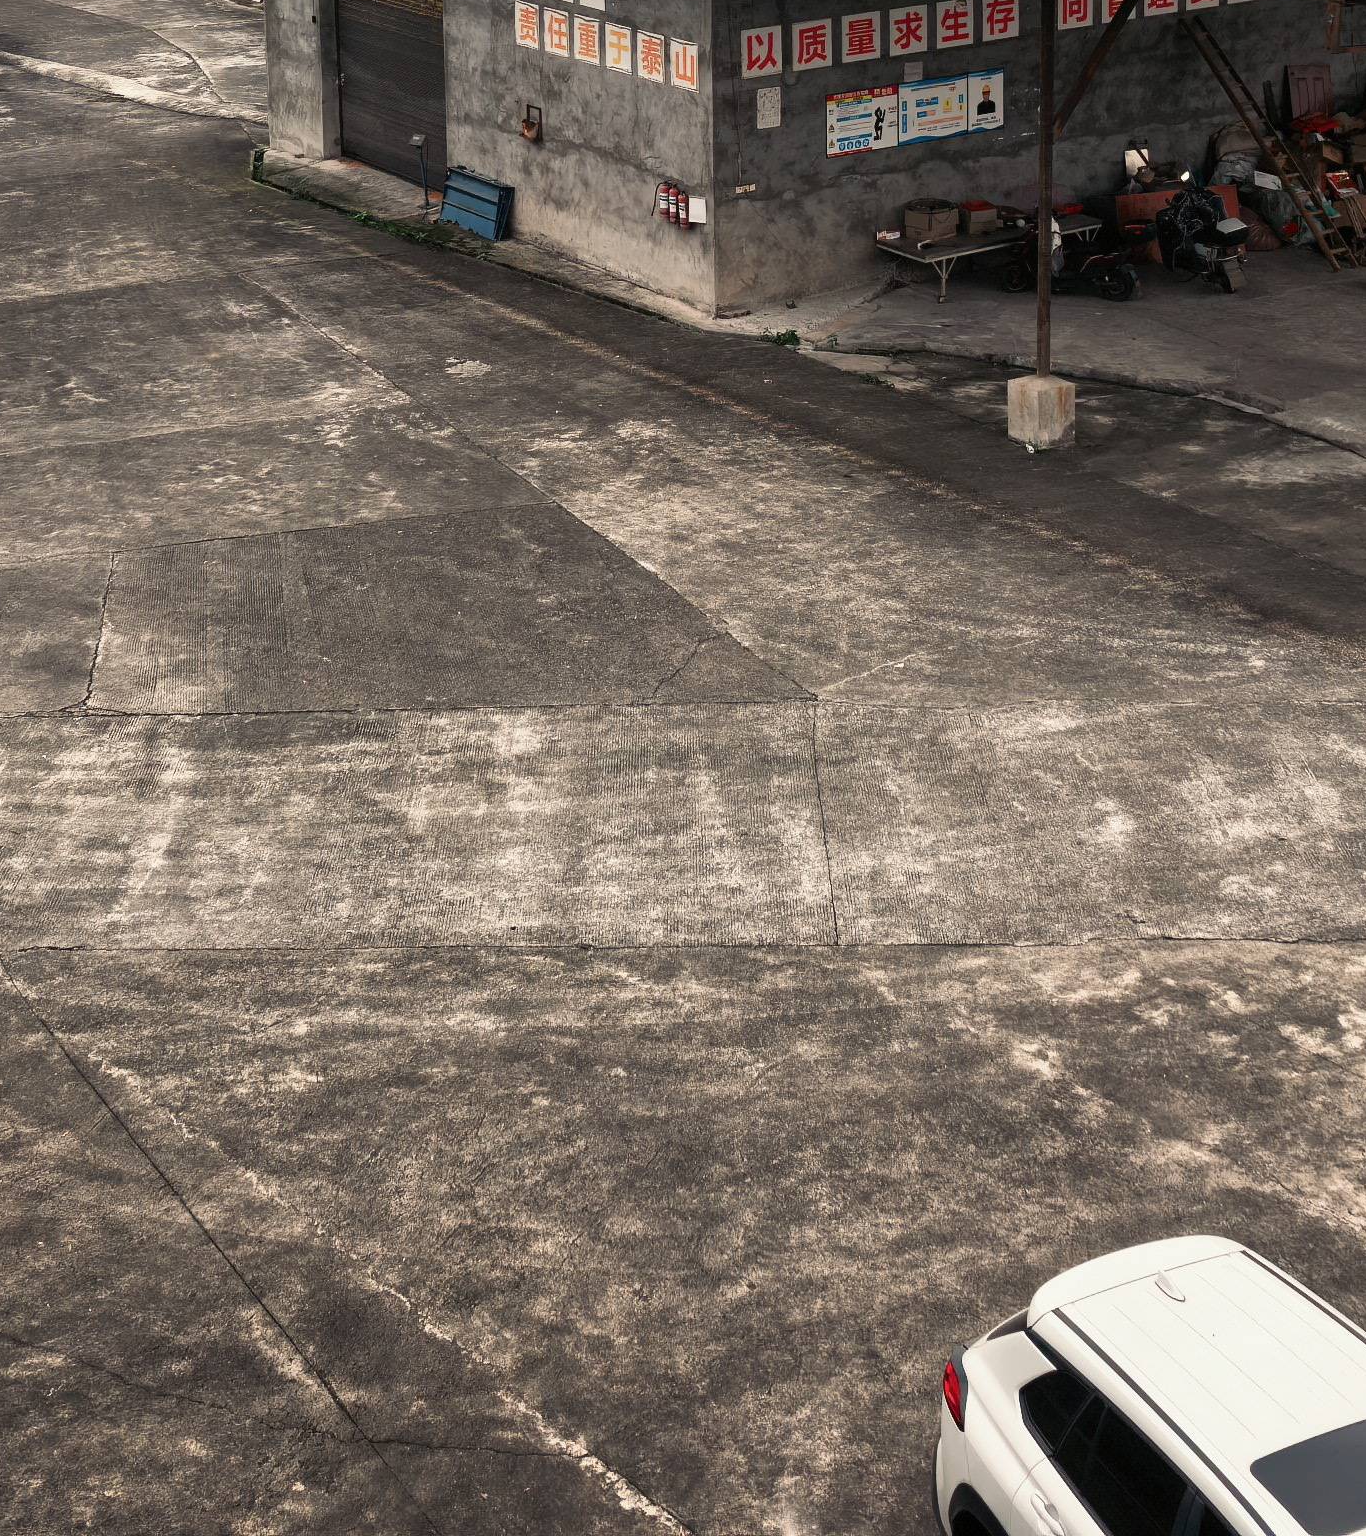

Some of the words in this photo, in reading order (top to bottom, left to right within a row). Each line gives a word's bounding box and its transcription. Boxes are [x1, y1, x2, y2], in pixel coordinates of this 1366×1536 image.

[518, 7, 700, 87] 责任重于泰山
